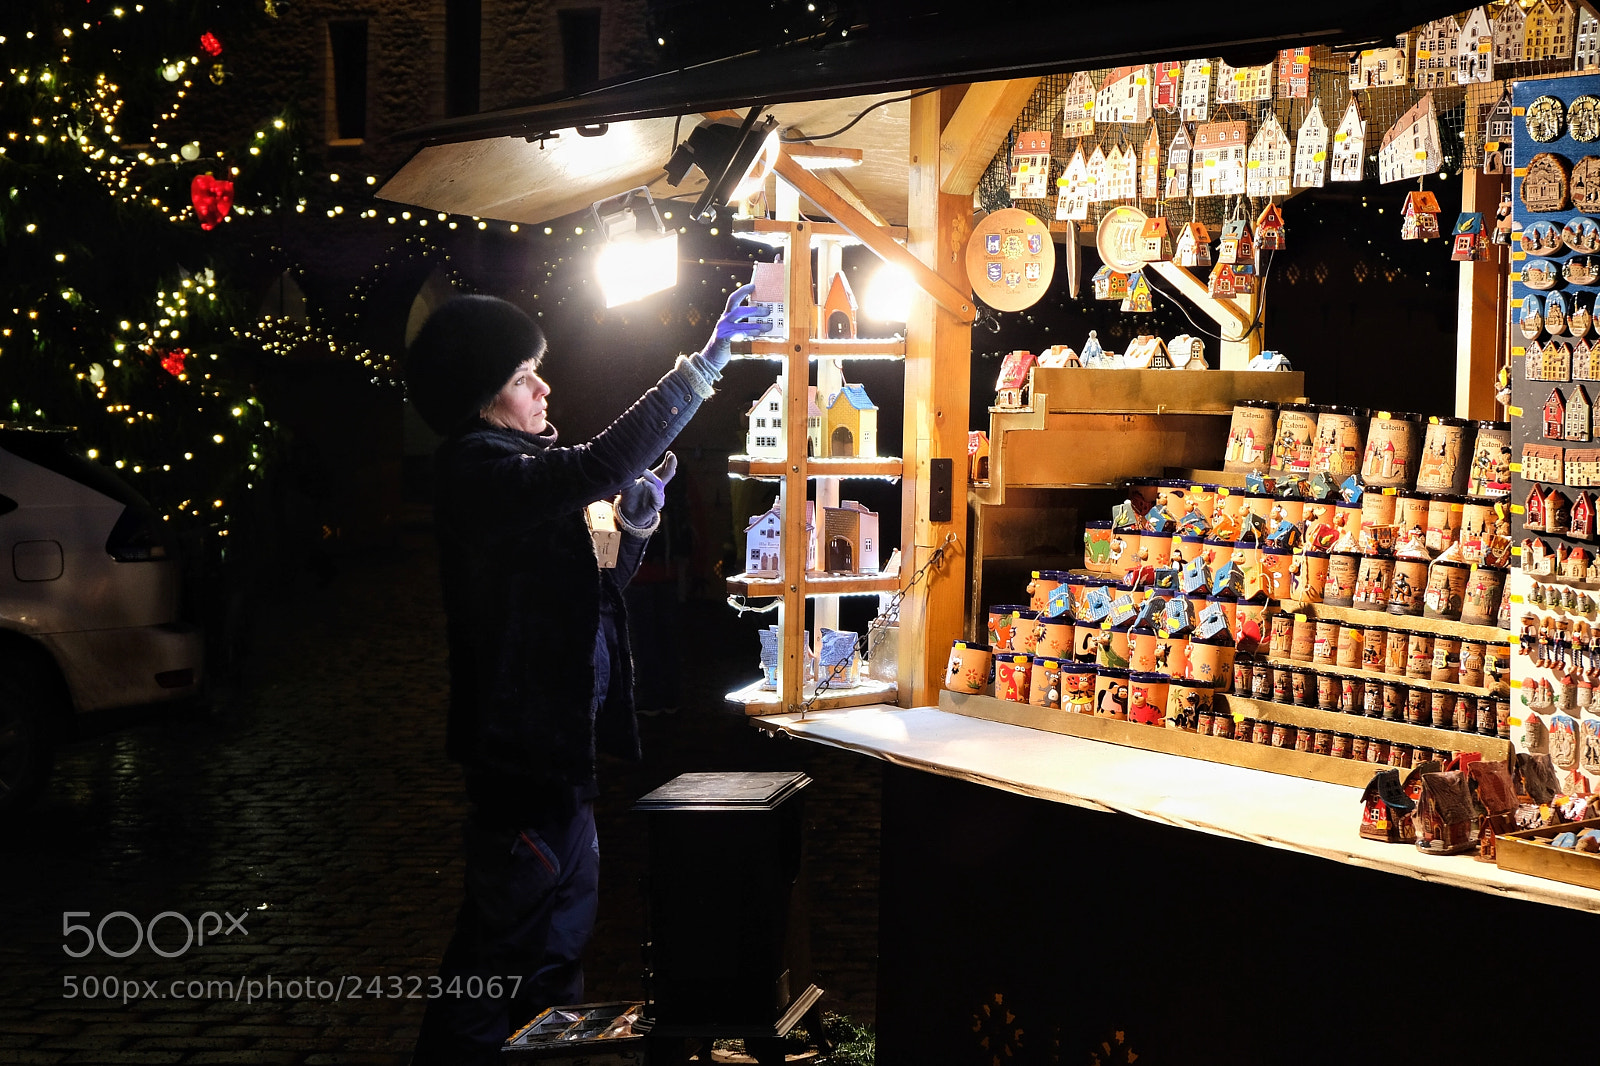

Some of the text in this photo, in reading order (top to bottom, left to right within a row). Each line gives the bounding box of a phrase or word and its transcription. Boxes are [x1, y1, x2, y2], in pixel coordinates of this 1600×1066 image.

[1240, 411, 1265, 420] Estonia
[1284, 420, 1308, 430] Estonia
[1379, 422, 1405, 432] Estonia
